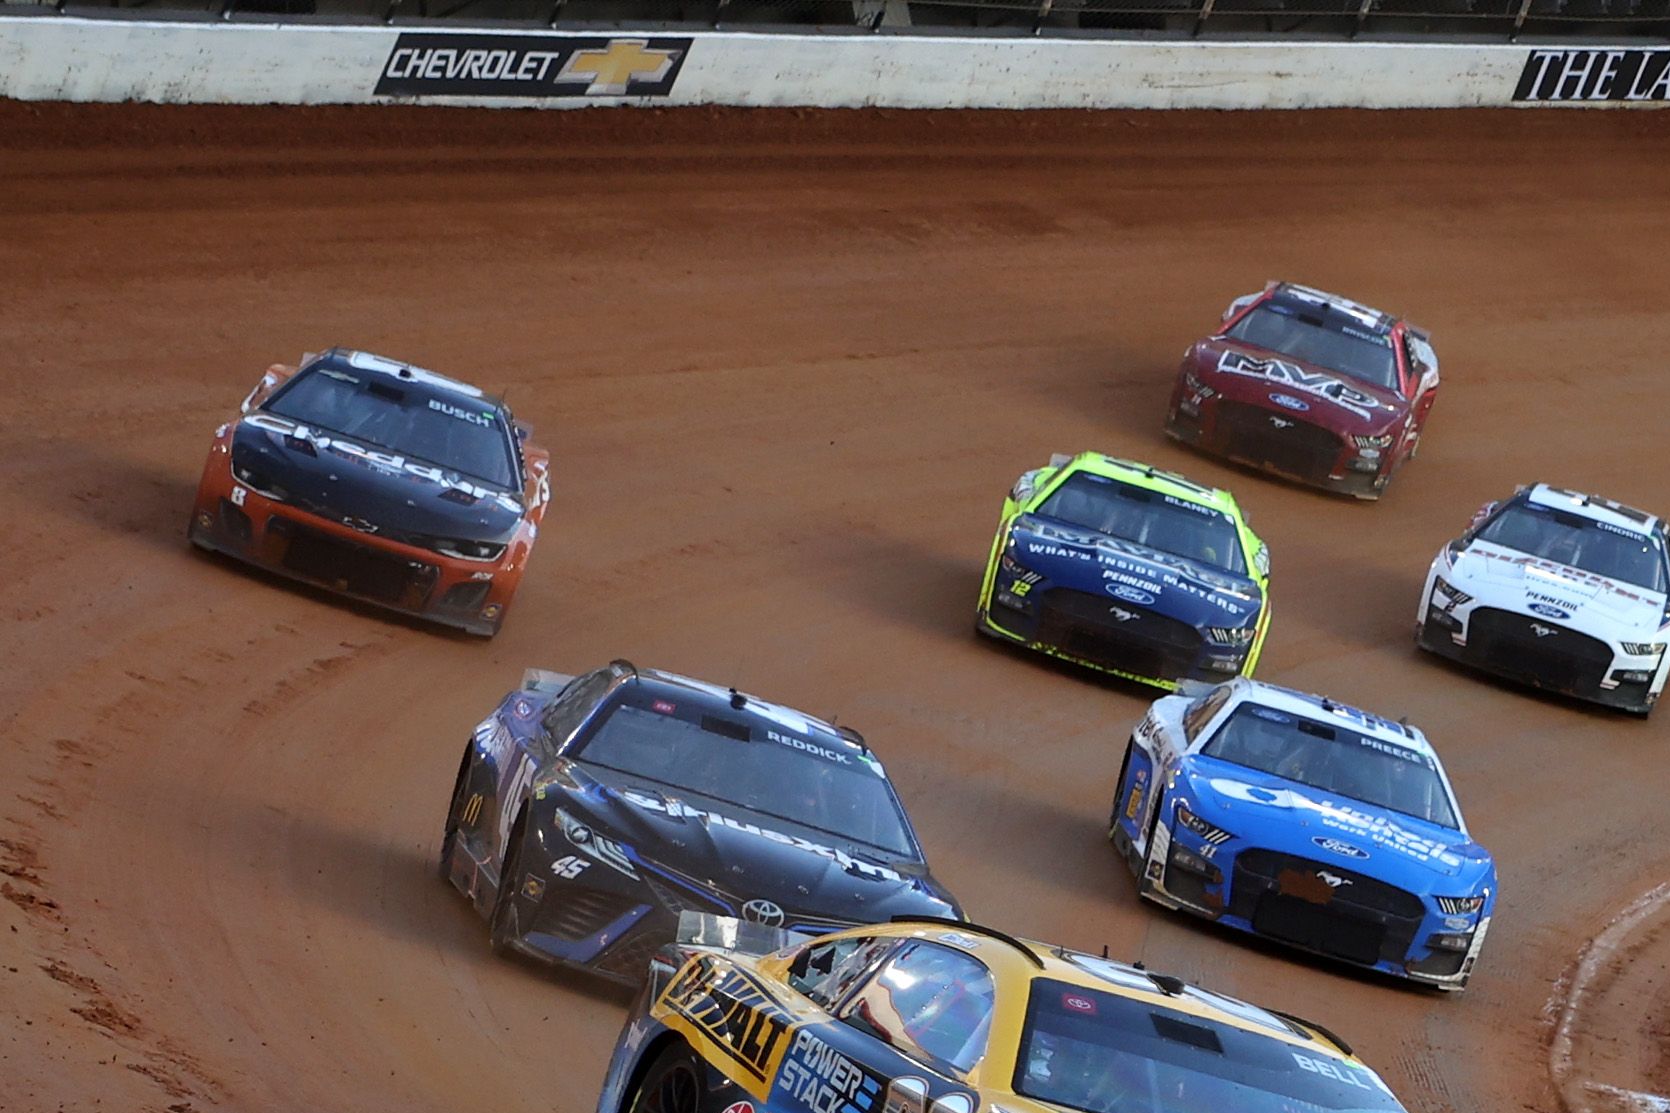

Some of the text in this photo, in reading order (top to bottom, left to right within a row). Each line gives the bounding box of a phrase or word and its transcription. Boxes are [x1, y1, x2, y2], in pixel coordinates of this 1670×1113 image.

[386, 49, 559, 80] CHEVROLET
[1530, 50, 1621, 99] THE
[1217, 350, 1380, 422] MVP
[428, 399, 489, 427] BUSCH
[231, 486, 247, 506] 8
[1164, 496, 1219, 518] BLANEY
[1596, 521, 1645, 543] CINDRIC
[1098, 554, 1158, 579] INSIDE
[1010, 579, 1032, 597] 12
[1102, 569, 1162, 595] PENNZOIL
[1114, 585, 1147, 601] Ford
[1525, 590, 1579, 612] PENNZOIL
[767, 731, 853, 766] REDDICK
[1360, 737, 1421, 763] PREECE
[1200, 844, 1217, 858] 41
[1322, 838, 1360, 857] Ford
[551, 856, 591, 879] 45
[791, 1029, 863, 1100] POWER
[1291, 1052, 1372, 1091] BELL
